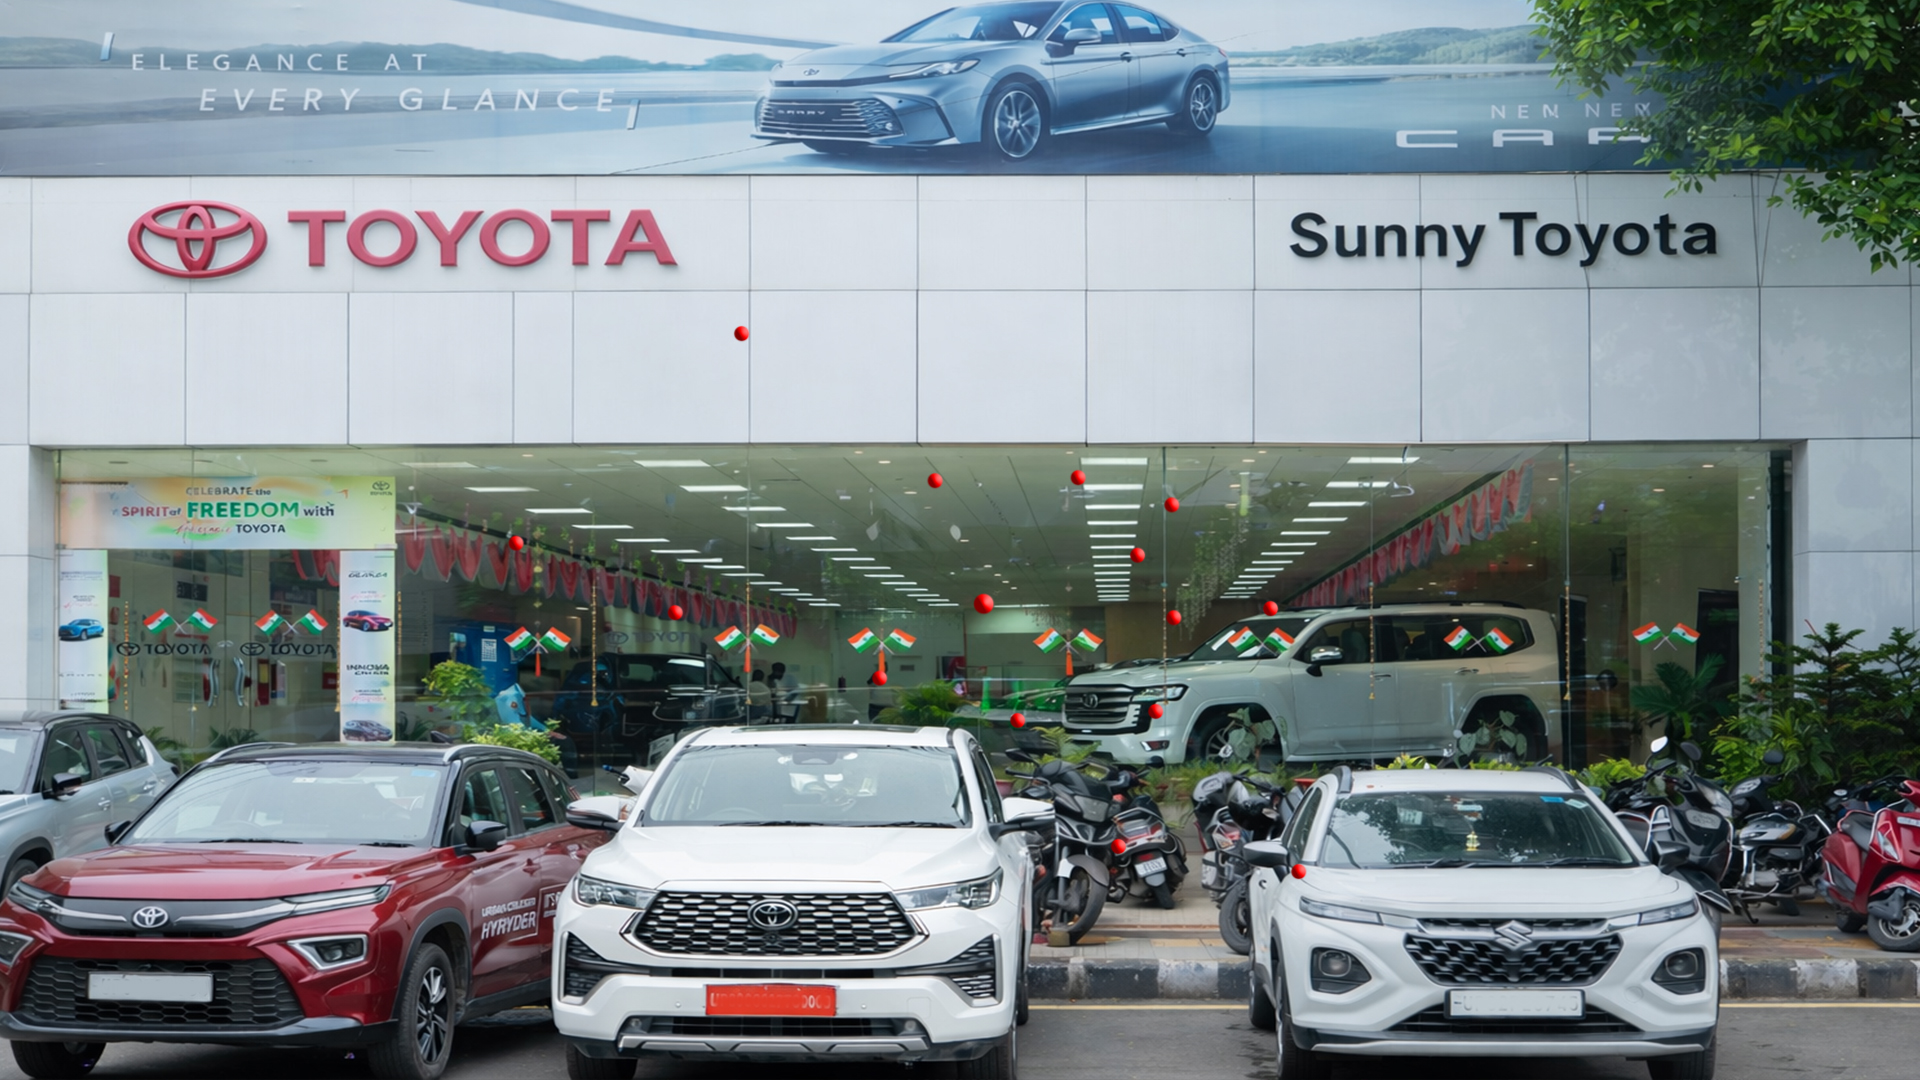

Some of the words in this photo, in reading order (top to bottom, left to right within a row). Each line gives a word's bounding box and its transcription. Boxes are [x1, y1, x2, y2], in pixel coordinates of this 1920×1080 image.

[132, 53, 349, 71] ELEGANCE
[384, 53, 427, 71] AT
[200, 88, 361, 112] EVERY
[399, 88, 616, 112] GLANCE
[288, 209, 678, 268] TOYOTA
[1289, 212, 1486, 268] Sunny
[1499, 211, 1718, 268] Toyota
[186, 486, 254, 496] CELEBRATE
[121, 506, 169, 517] SPIRIT
[187, 501, 299, 518] FREEDOM
[303, 503, 335, 517] with
[236, 523, 286, 534] TOYOTA
[481, 911, 537, 940] HYRYDER
